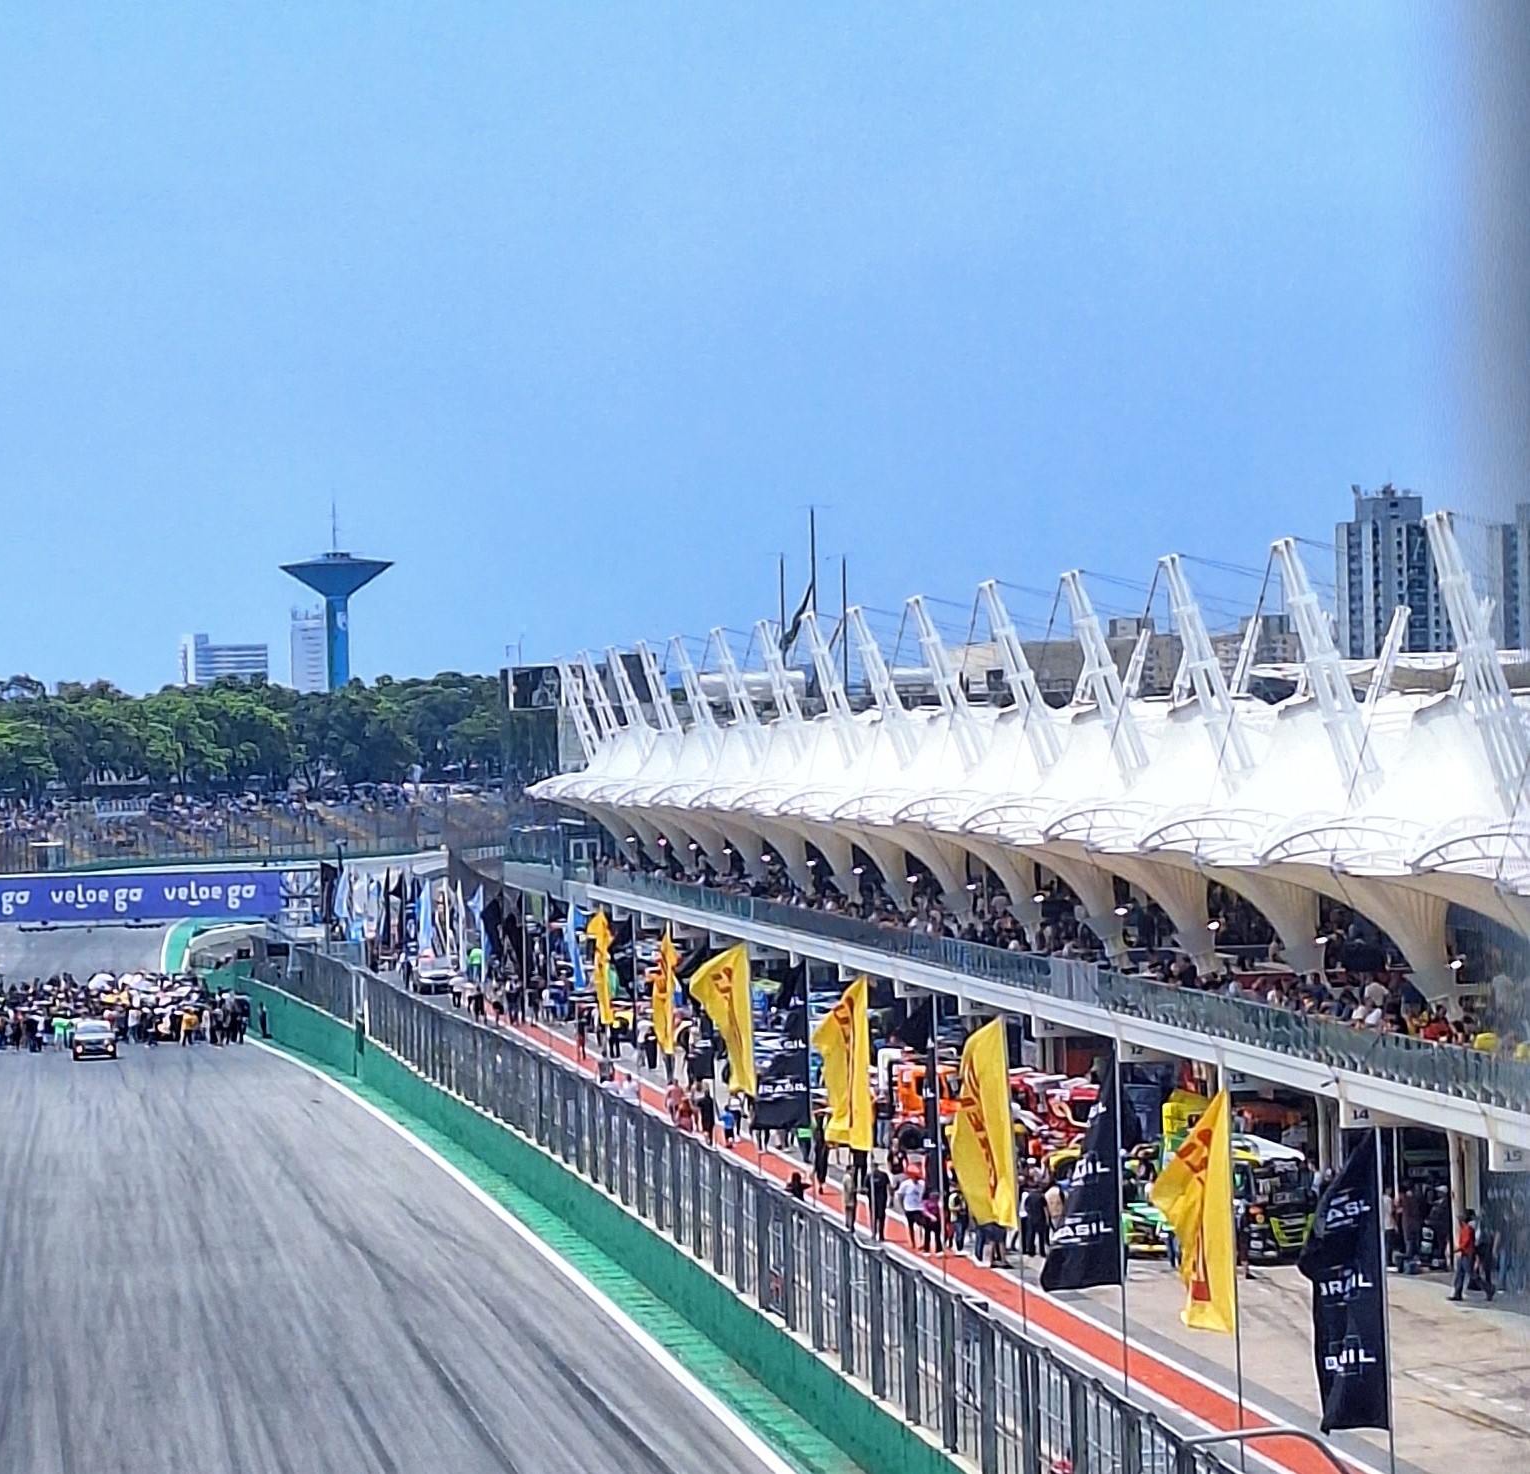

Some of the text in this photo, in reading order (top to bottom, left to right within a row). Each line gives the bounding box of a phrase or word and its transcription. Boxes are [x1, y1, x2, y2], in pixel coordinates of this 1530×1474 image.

[51, 884, 109, 909] veloe
[164, 881, 222, 905] veloe
[1353, 1109, 1370, 1120] 14
